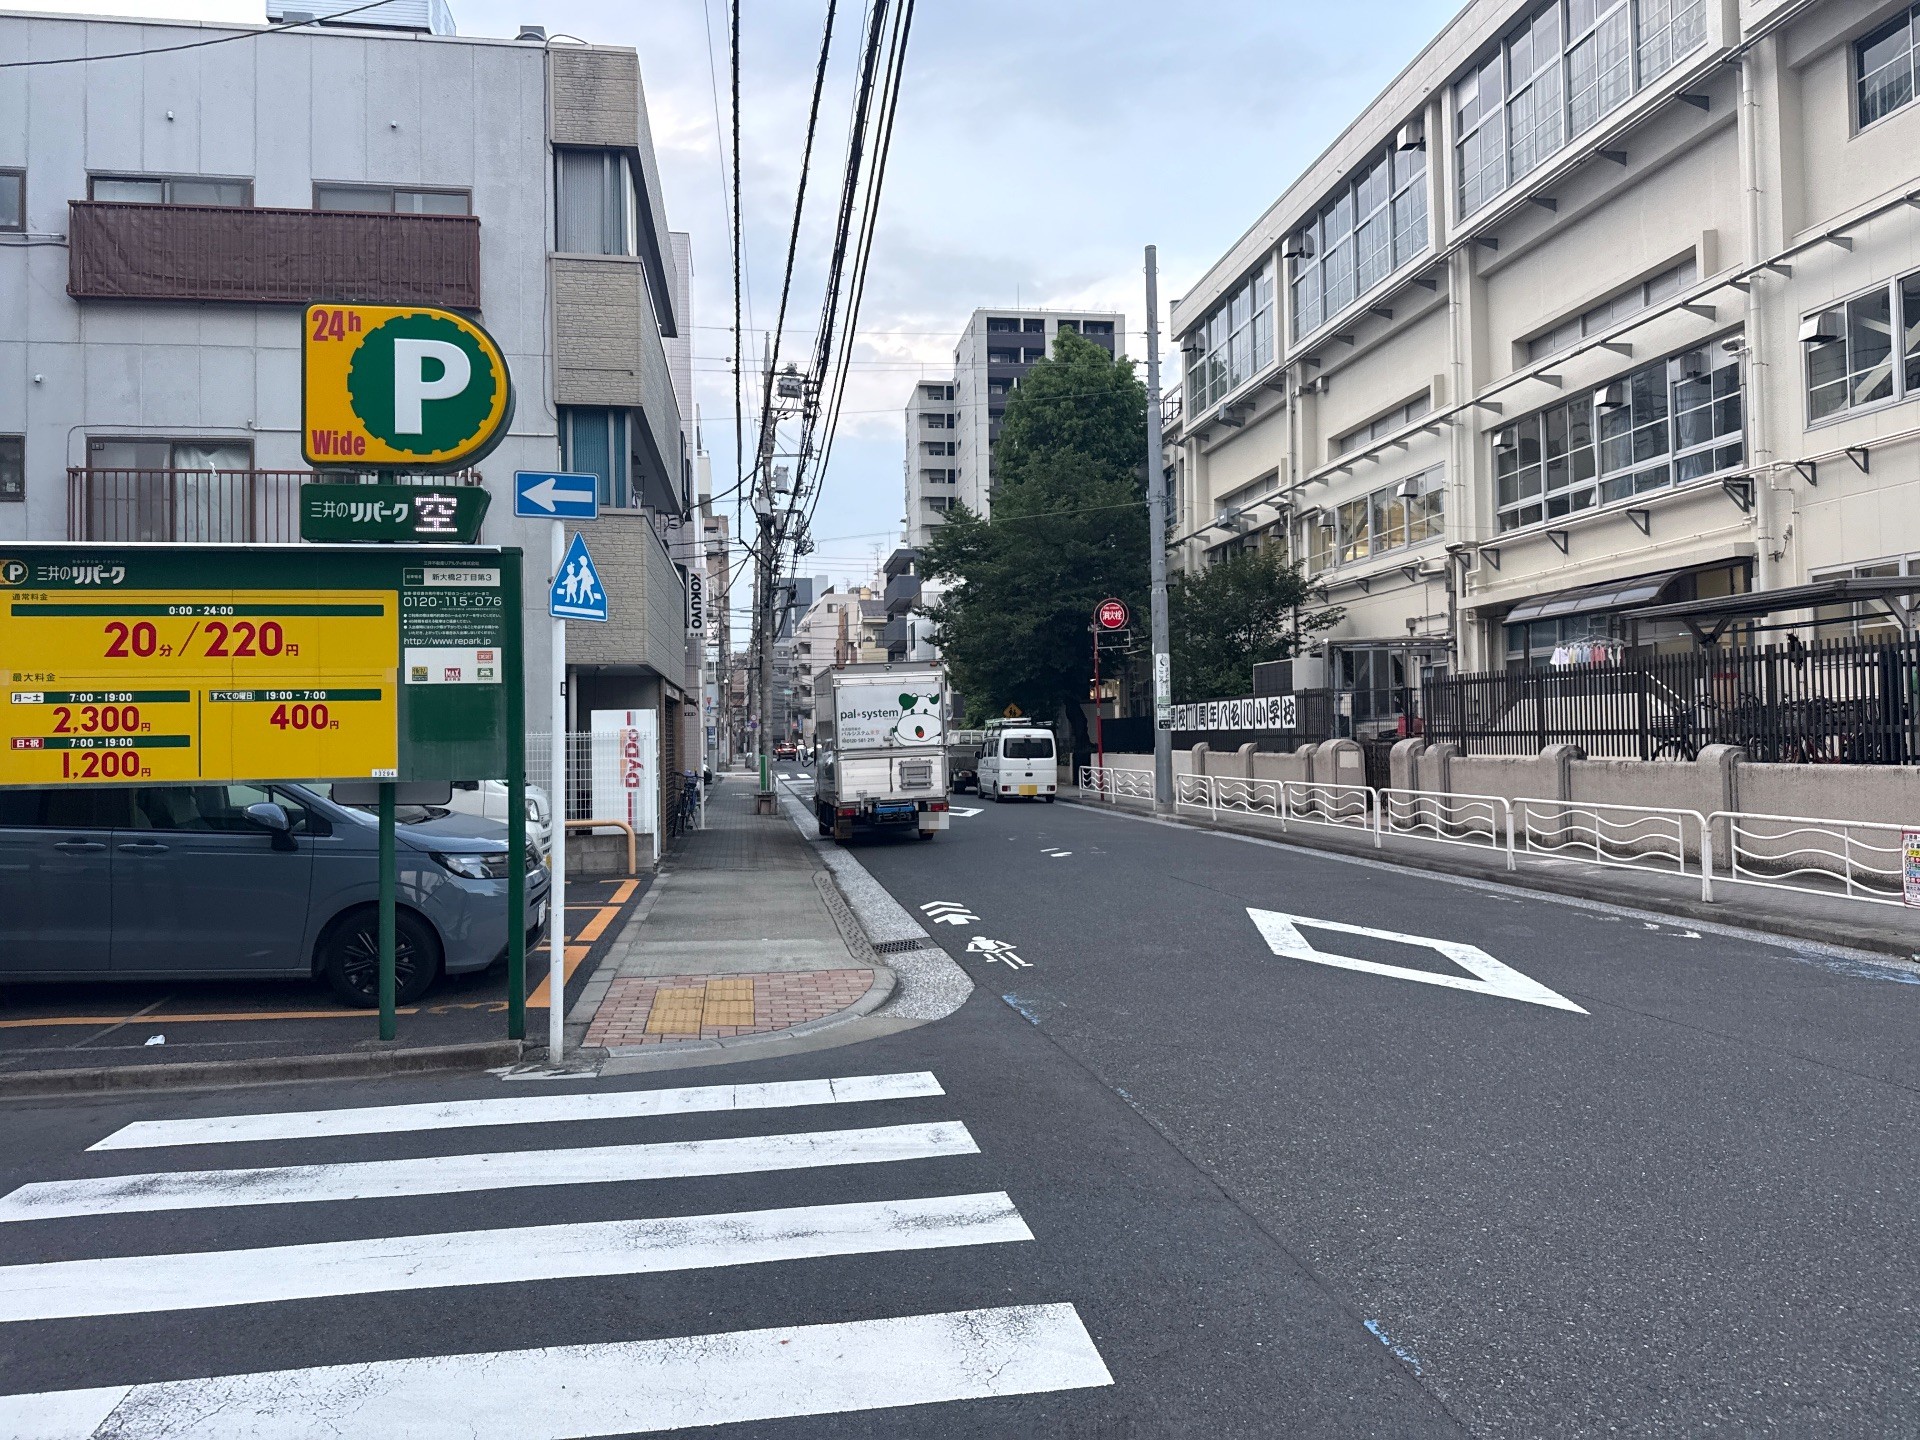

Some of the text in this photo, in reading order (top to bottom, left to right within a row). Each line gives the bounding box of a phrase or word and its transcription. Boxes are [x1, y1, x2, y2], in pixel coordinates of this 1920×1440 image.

[312, 310, 362, 341] 24h
[394, 338, 471, 435] P
[312, 430, 366, 455] Wide
[311, 501, 409, 523] 三井のリパーク
[415, 493, 458, 532] 空
[10, 564, 23, 580] P
[37, 565, 125, 584] 三井のリパーク
[12, 593, 48, 601] 通常料金
[403, 597, 502, 607] 0120-115-076
[691, 573, 702, 629] KOKUYO
[1103, 610, 1122, 620] 消火栓
[12, 673, 56, 682] 最大料金
[212, 692, 253, 700] すべての曜日
[52, 705, 151, 733] 2,300円
[270, 704, 339, 730] 400円
[63, 751, 151, 779] 1,200円
[625, 728, 644, 788] DyDo
